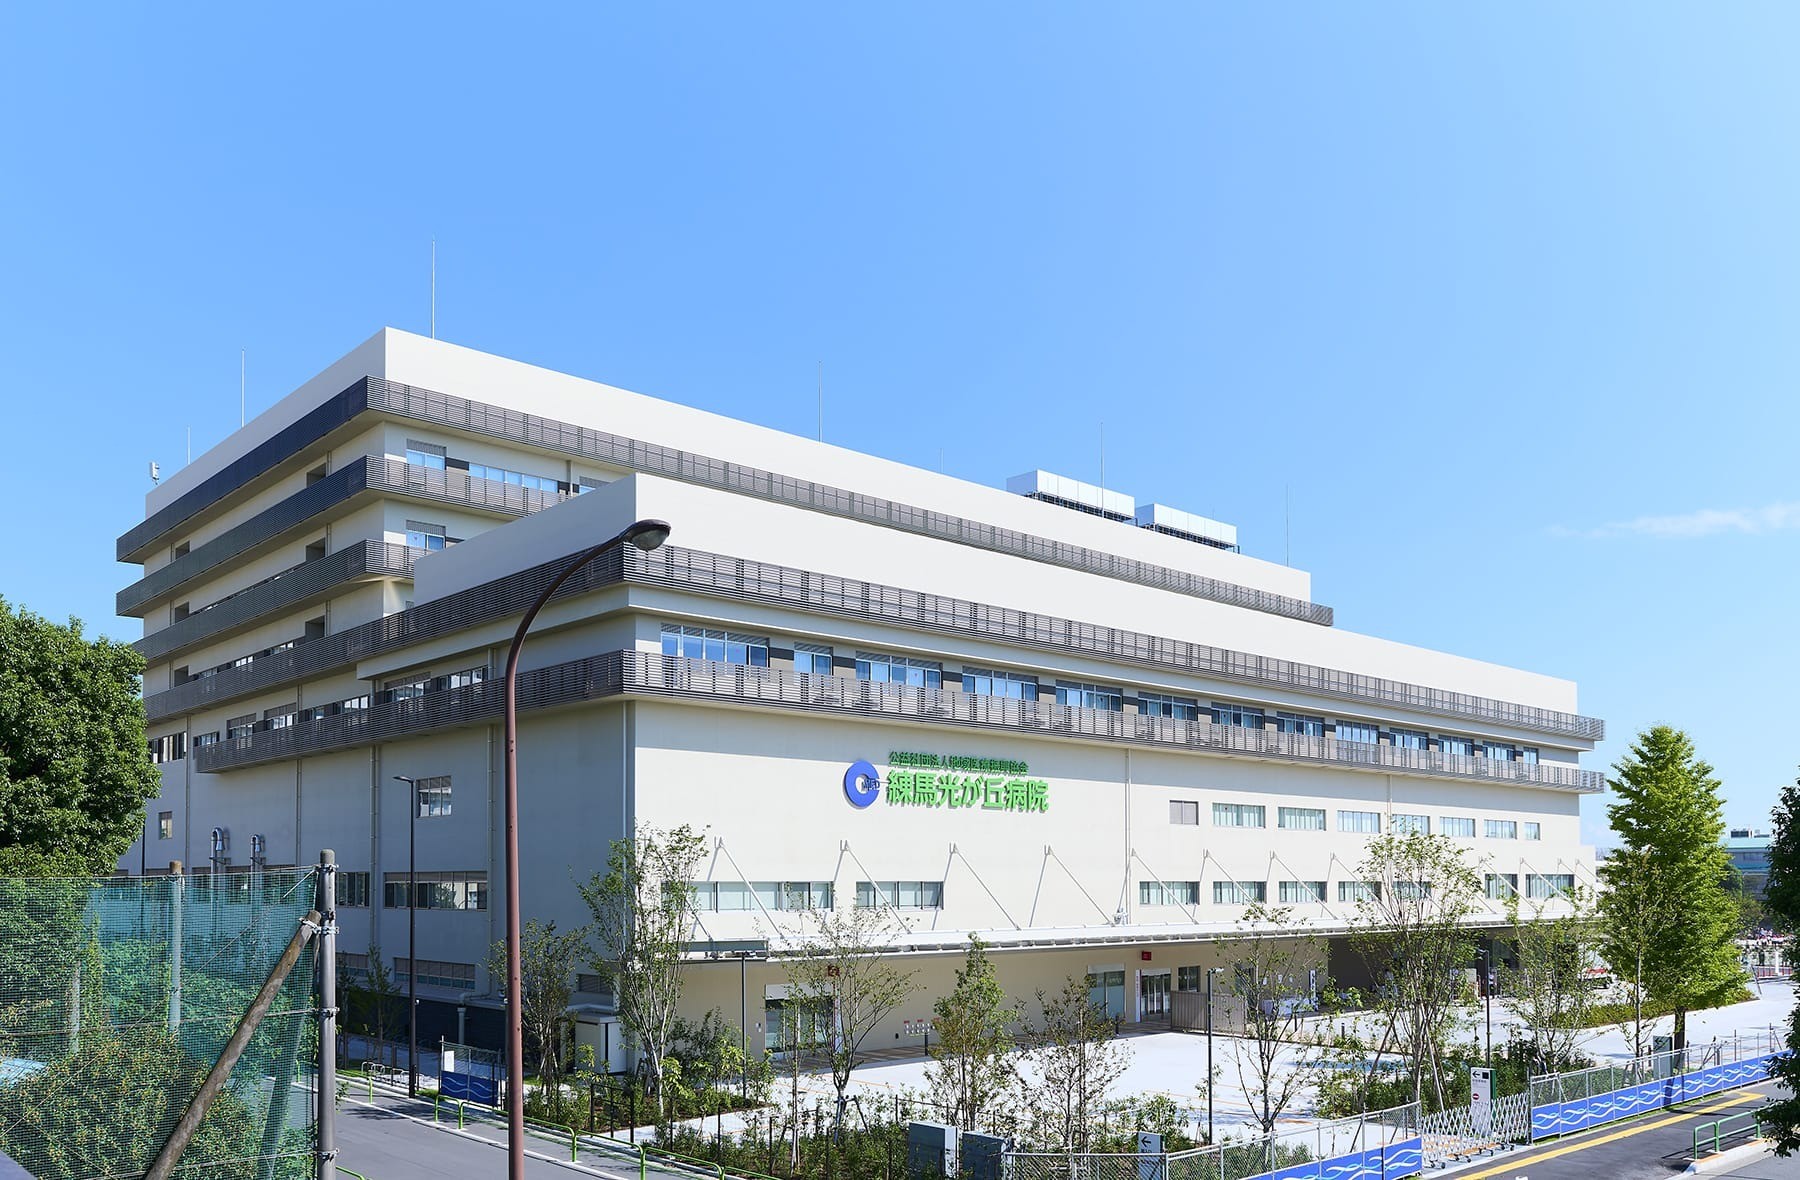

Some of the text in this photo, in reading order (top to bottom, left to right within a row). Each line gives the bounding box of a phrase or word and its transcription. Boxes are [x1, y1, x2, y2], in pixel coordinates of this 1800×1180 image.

[887, 770, 1049, 811] 練馬光が丘病院
